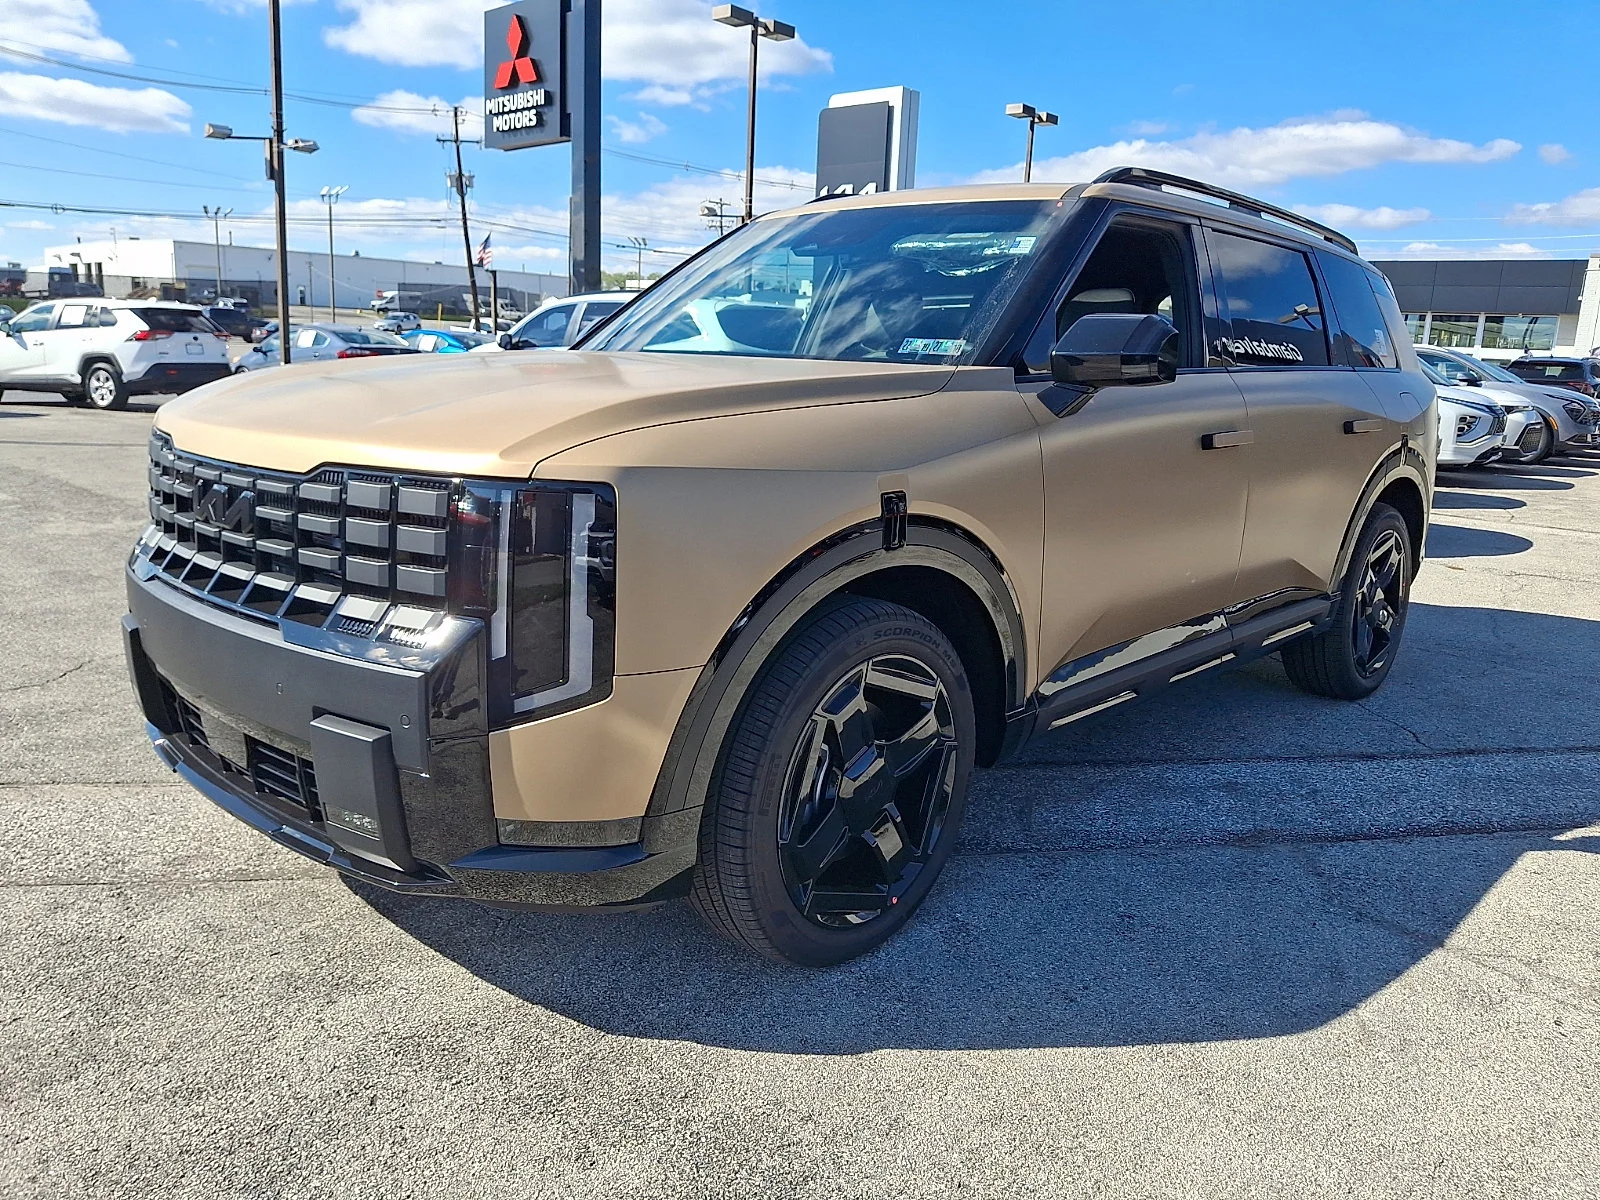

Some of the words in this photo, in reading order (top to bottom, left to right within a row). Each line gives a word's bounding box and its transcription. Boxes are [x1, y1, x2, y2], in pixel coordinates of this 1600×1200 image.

[485, 88, 545, 115] MITSUBISHI
[492, 108, 537, 132] MOTORS
[873, 627, 941, 649] SCORPION
